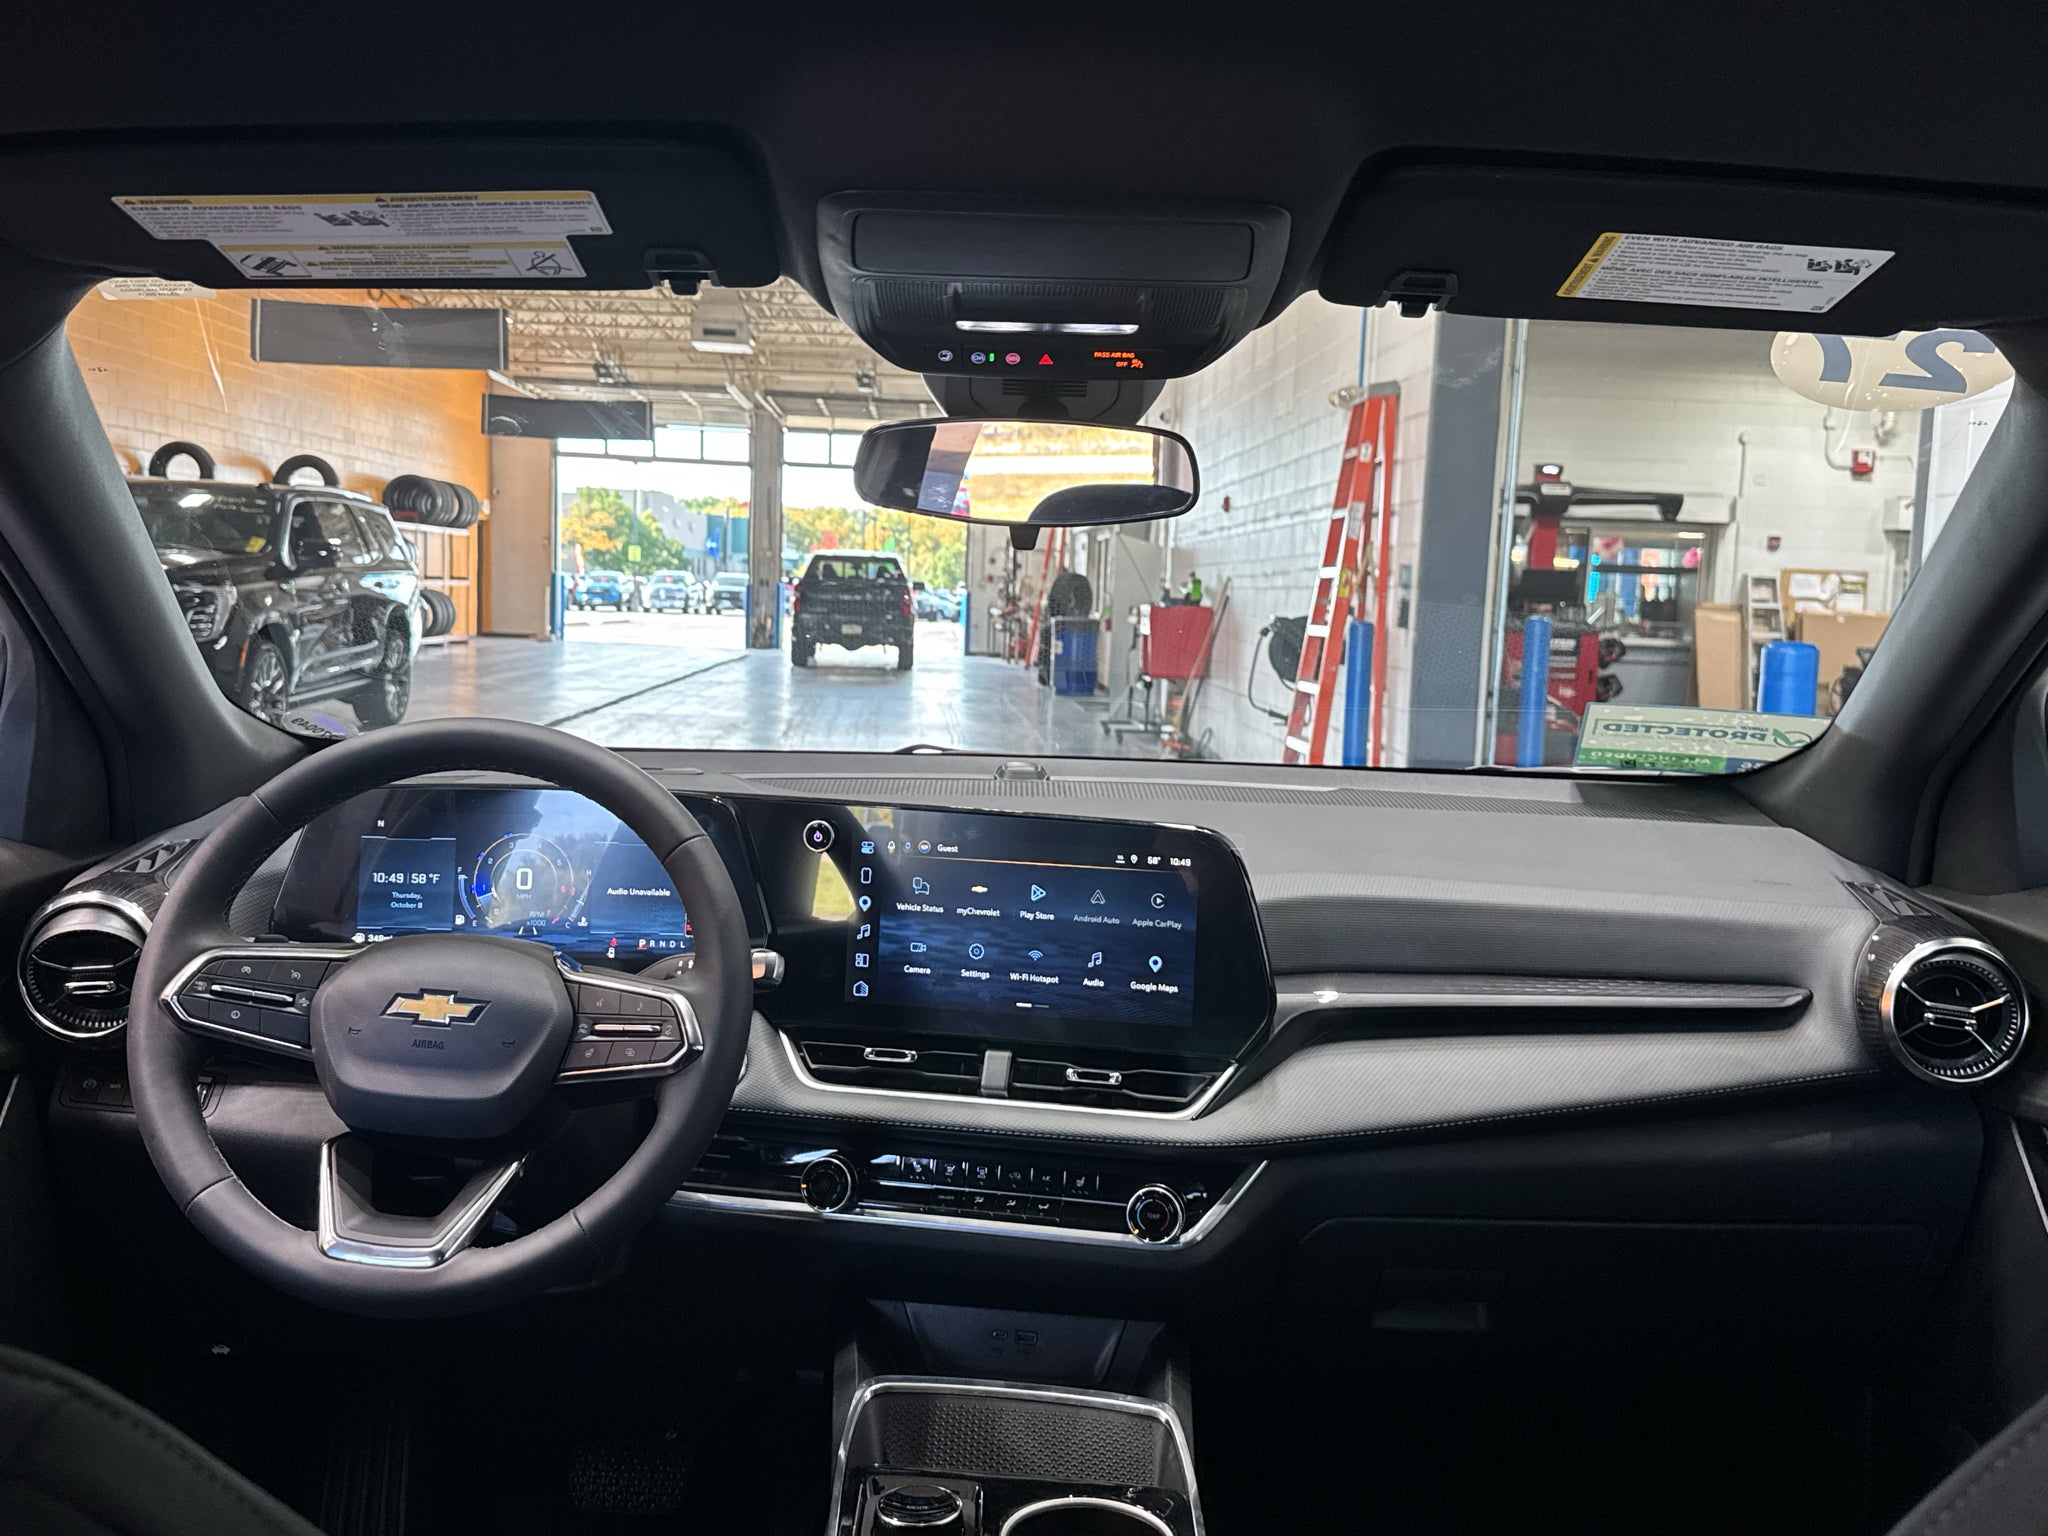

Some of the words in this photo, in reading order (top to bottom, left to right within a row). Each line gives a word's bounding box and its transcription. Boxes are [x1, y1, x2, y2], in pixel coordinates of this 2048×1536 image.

[1680, 238, 1734, 248] ADVANCED
[937, 844, 959, 853] Guest
[1170, 858, 1191, 866] 10:49
[372, 872, 404, 884] 10:49
[411, 873, 427, 884] 58
[516, 868, 533, 890] 0
[392, 892, 423, 900] Thursday,
[630, 888, 670, 896] Unavailable
[896, 902, 921, 912] Vehicle
[922, 904, 944, 913] Status
[957, 908, 1000, 917] myChevrolet
[1020, 910, 1034, 920] Play
[1035, 912, 1055, 920] Store
[1073, 914, 1102, 924] Android
[1103, 916, 1120, 925] Auto
[1132, 918, 1154, 928] Apple
[1154, 920, 1183, 930] CarPlay
[639, 939, 647, 947] P
[660, 940, 665, 948] N
[904, 965, 931, 974] Camera
[961, 969, 990, 980] Settings
[1010, 972, 1028, 982] Wi-Fi
[1029, 974, 1059, 984] Hotspot
[1083, 978, 1105, 987] Audio
[1130, 981, 1157, 992] Google
[1158, 983, 1178, 993] Maps
[411, 1038, 445, 1050] AIRBAG
